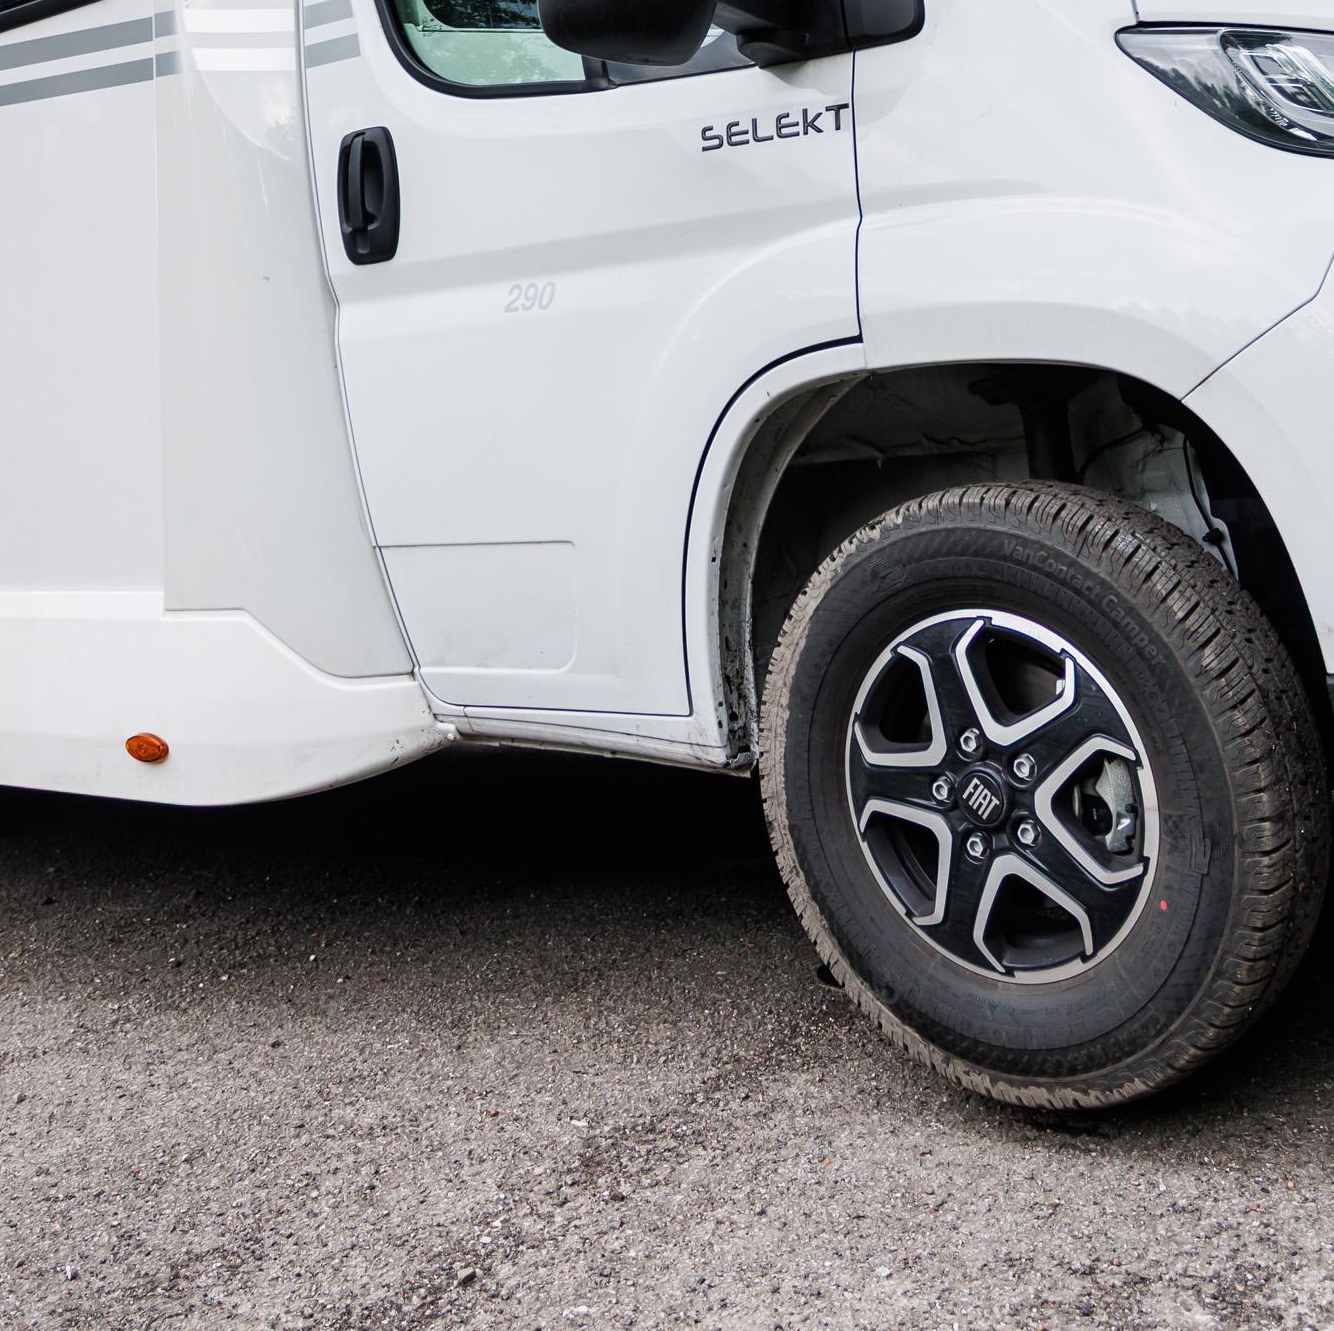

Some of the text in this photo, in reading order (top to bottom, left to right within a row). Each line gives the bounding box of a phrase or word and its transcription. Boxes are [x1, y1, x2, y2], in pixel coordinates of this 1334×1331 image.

[701, 102, 850, 152] SELEKT
[503, 281, 556, 313] 290
[1003, 538, 1165, 665] VanContact Camper
[962, 777, 1000, 820] FIAT
